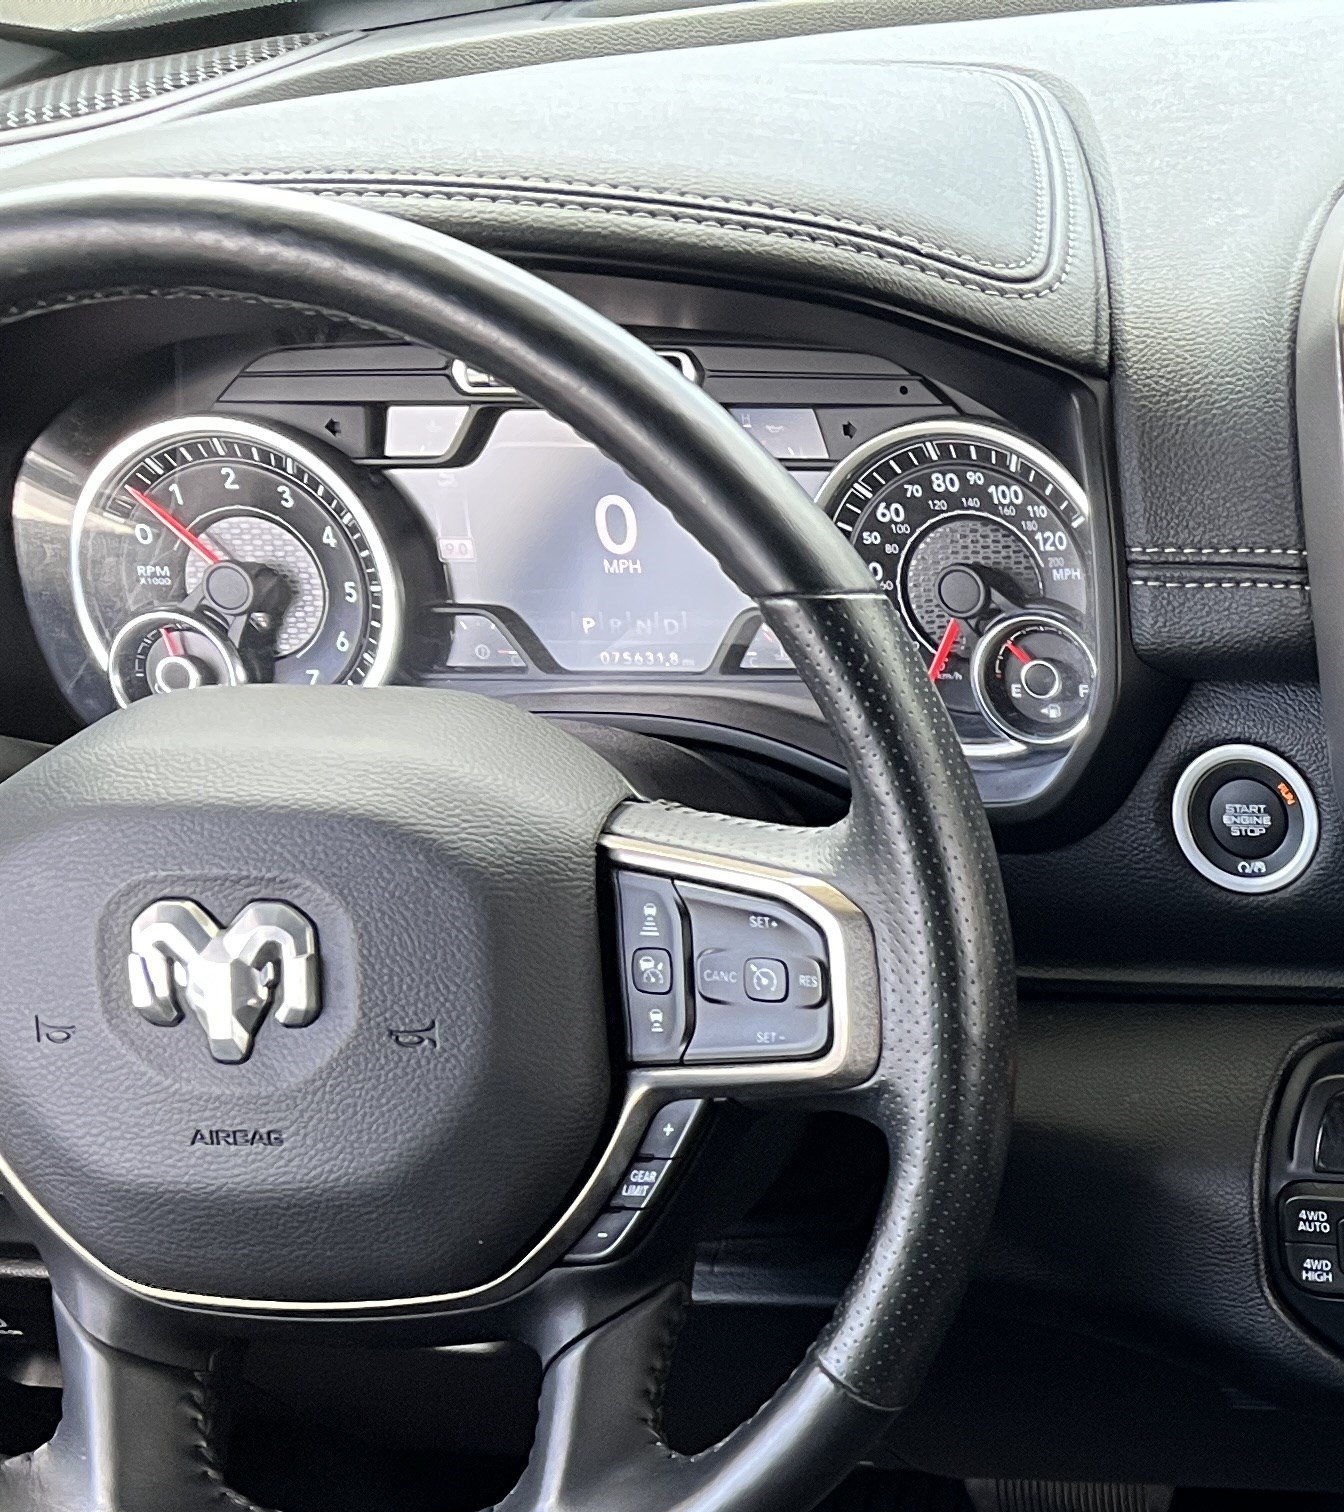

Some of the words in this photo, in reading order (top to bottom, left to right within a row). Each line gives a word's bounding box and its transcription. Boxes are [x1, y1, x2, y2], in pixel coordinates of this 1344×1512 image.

[221, 468, 240, 490] 2
[931, 473, 959, 492] 80
[966, 471, 984, 485] 90
[169, 484, 183, 505] 1
[277, 485, 294, 508] 3
[904, 484, 923, 498] 70
[988, 485, 1023, 504] 100
[928, 500, 947, 510] 120
[962, 498, 980, 508] 140
[876, 502, 905, 523] 60
[998, 506, 1016, 516] 160
[1027, 505, 1047, 518] 110
[595, 494, 638, 555] 0
[891, 523, 911, 534] 100
[135, 523, 153, 544] 0
[322, 526, 337, 548] 4
[862, 532, 881, 545] 50
[1035, 531, 1067, 551] 120
[885, 543, 899, 554] 80
[136, 566, 170, 578] RPM
[603, 559, 642, 574] MPH
[1052, 568, 1081, 580] MPH
[343, 582, 358, 603] 5
[336, 631, 349, 652] 6
[1225, 803, 1267, 814] START
[1223, 814, 1271, 828] ENGINE
[1230, 827, 1267, 837] STOP
[703, 970, 738, 984] CANC
[190, 1129, 284, 1146] AIRBAG
[630, 1170, 657, 1183] GEAR
[622, 1185, 650, 1196] LIMIT
[1299, 1210, 1328, 1222] 4WD
[1298, 1222, 1330, 1234] AUTO
[1303, 1259, 1332, 1271] 4WD
[1302, 1271, 1333, 1283] HIGH
